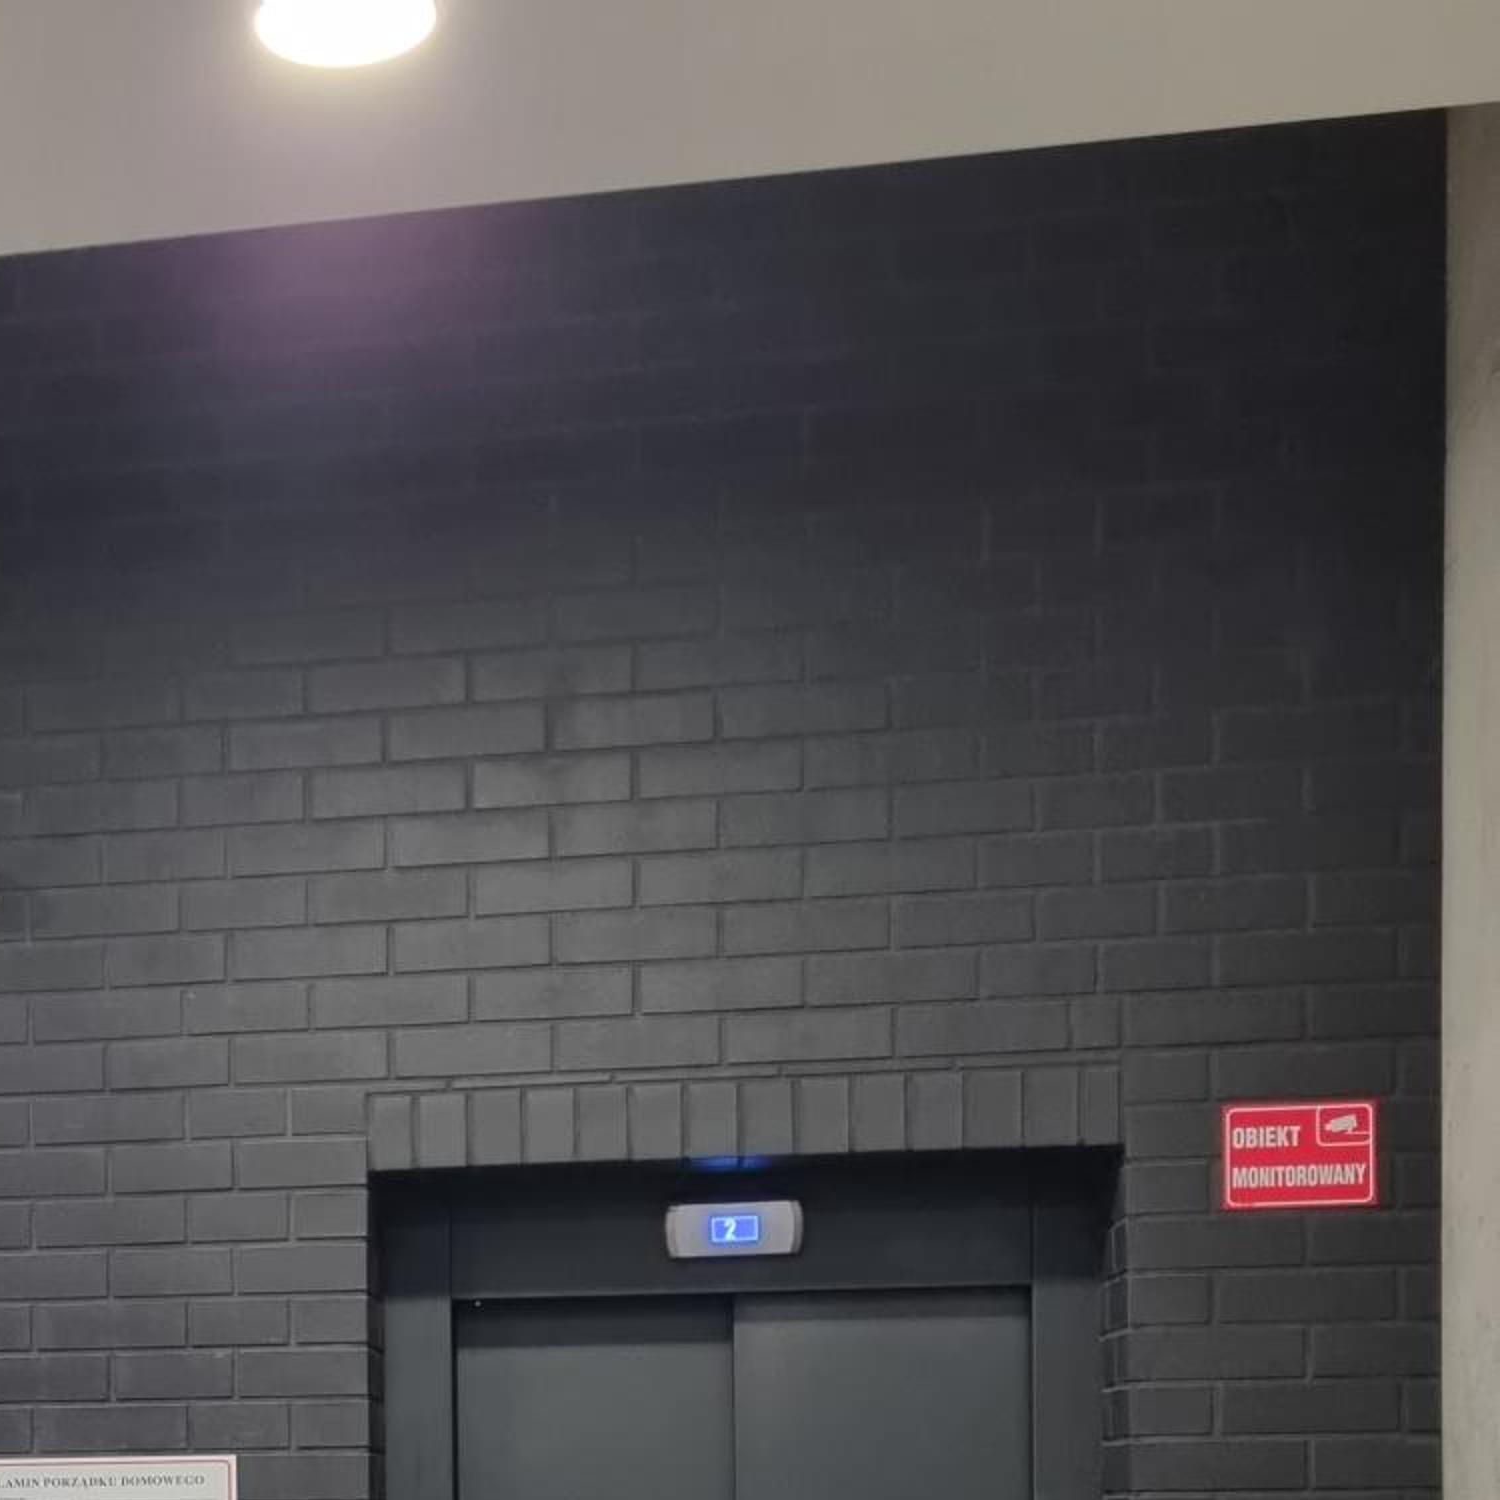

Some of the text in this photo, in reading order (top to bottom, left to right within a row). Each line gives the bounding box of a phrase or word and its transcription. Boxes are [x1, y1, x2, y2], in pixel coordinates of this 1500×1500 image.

[1233, 1126, 1301, 1148] OBIEKT
[1233, 1164, 1366, 1188] MONITOROWANY
[724, 1217, 737, 1241] 2
[43, 1477, 117, 1490] PORZĄDKU
[121, 1475, 205, 1487] DOMOWEGO
